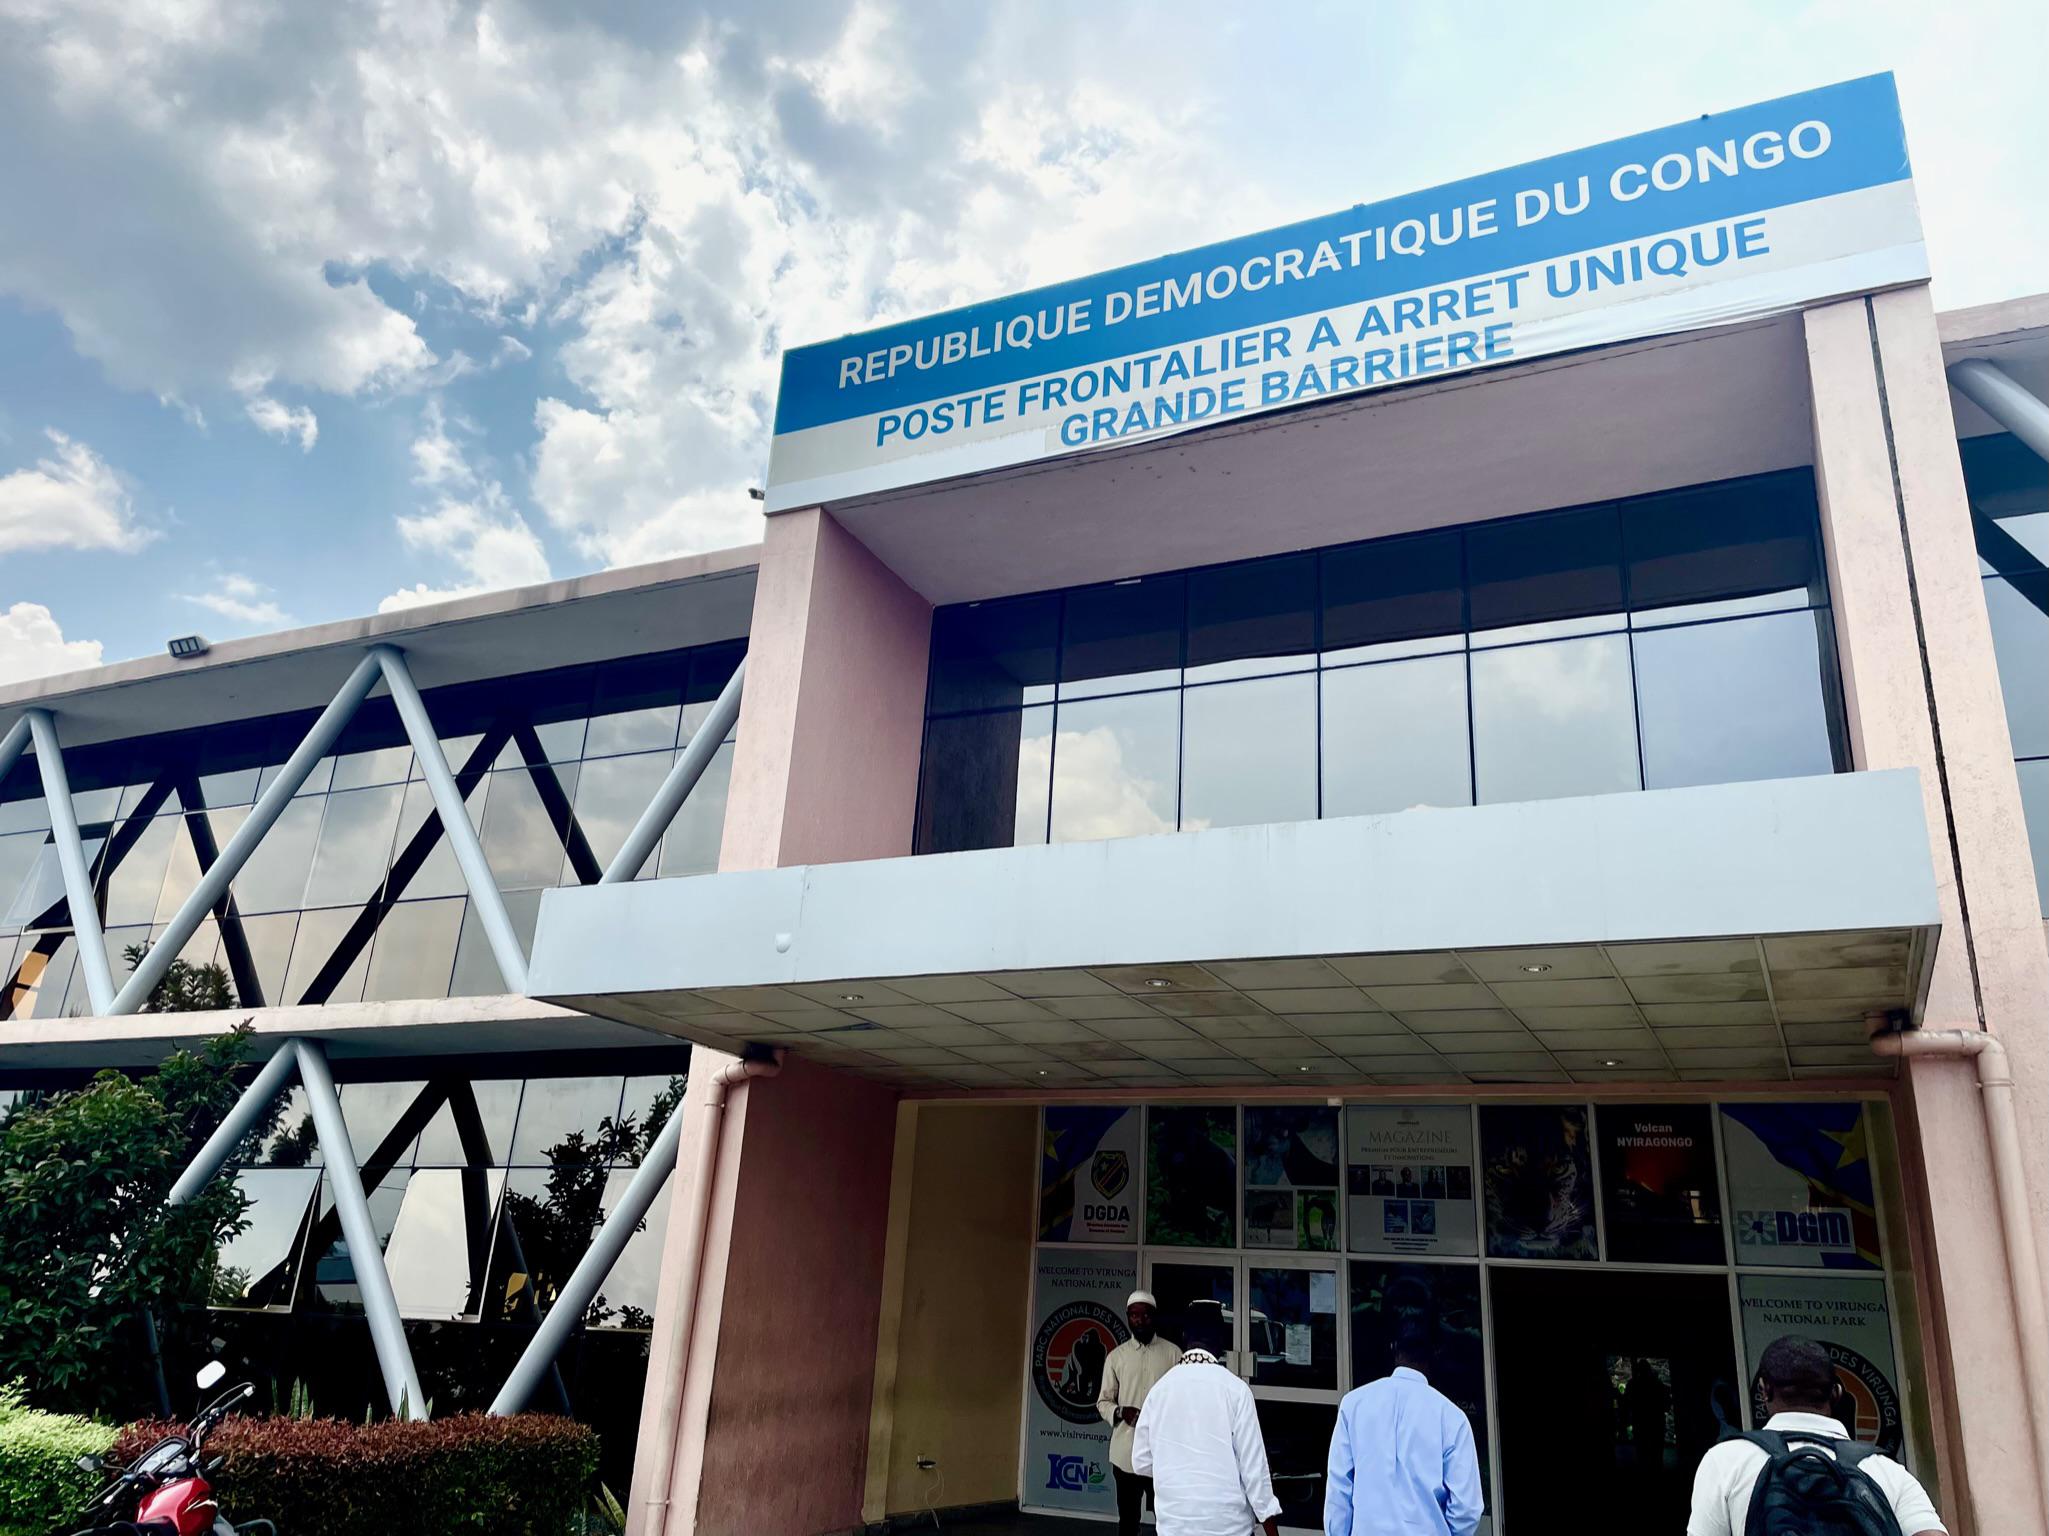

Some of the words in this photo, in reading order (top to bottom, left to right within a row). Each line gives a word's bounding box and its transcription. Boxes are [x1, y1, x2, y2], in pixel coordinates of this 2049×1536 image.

[838, 299, 1092, 389] REPUBLIQUE
[1104, 199, 1498, 326] DEMOCRATIQUE
[1515, 176, 1590, 228] DU
[1609, 120, 1832, 202] CONGO
[876, 393, 1006, 447] POSTE
[1018, 327, 1292, 416] FRONTALIER
[1305, 316, 1342, 353] A
[1355, 271, 1531, 343] ARRET
[1546, 217, 1770, 298] UNIQUE
[1060, 378, 1246, 447] GRANDE
[1261, 324, 1515, 405] BARRIERE
[1633, 1123, 1673, 1133] Volcan
[1369, 1130, 1453, 1145] MAGAZINE
[1616, 1136, 1693, 1148] NYIRAGONGO
[1084, 1205, 1130, 1221] DGDA
[1038, 1266, 1081, 1275] WELCOME
[1083, 1267, 1094, 1275] TO
[1096, 1268, 1137, 1277] VIRUNGA
[1051, 1279, 1097, 1288] NATIONAL
[1098, 1280, 1122, 1289] PARK
[1741, 1298, 1802, 1309] WELCOME
[1804, 1300, 1823, 1310] TO
[1825, 1301, 1887, 1312] VIRUNGA
[1763, 1313, 1830, 1325] NATIONAL
[1832, 1316, 1867, 1326] PARK
[1035, 1335, 1048, 1367] PARC
[1045, 1304, 1092, 1336] NATIONAL
[1093, 1307, 1113, 1322] DES
[1829, 1347, 1859, 1368] DES
[1860, 1363, 1897, 1428] VIRUNGA
